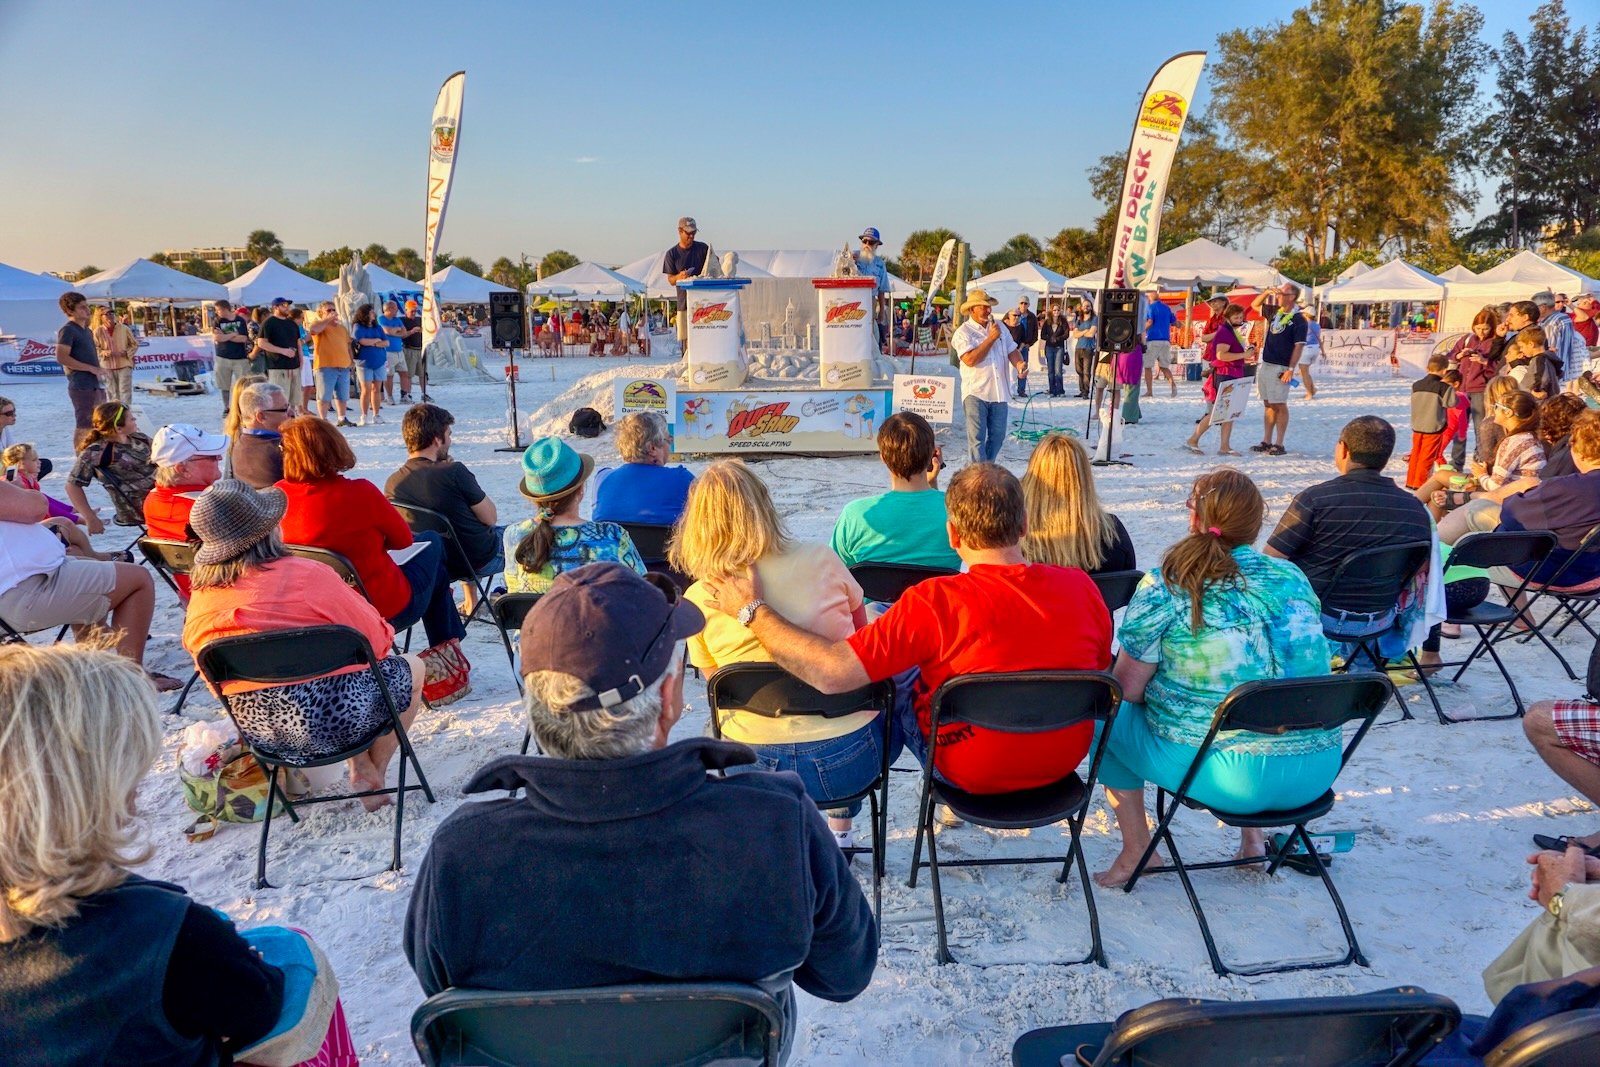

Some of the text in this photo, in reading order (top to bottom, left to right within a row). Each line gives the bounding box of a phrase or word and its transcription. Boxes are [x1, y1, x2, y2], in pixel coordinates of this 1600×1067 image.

[1126, 147, 1153, 220] DECK
[1132, 180, 1158, 243] BAR
[1320, 335, 1389, 351] HYATT
[132, 353, 185, 365] EMETRIO'S
[7, 365, 42, 373] HERE'S
[903, 379, 947, 389] CAPTAIN CURT'S
[726, 402, 800, 438] QUICK SAND
[937, 724, 976, 747] DEMY
